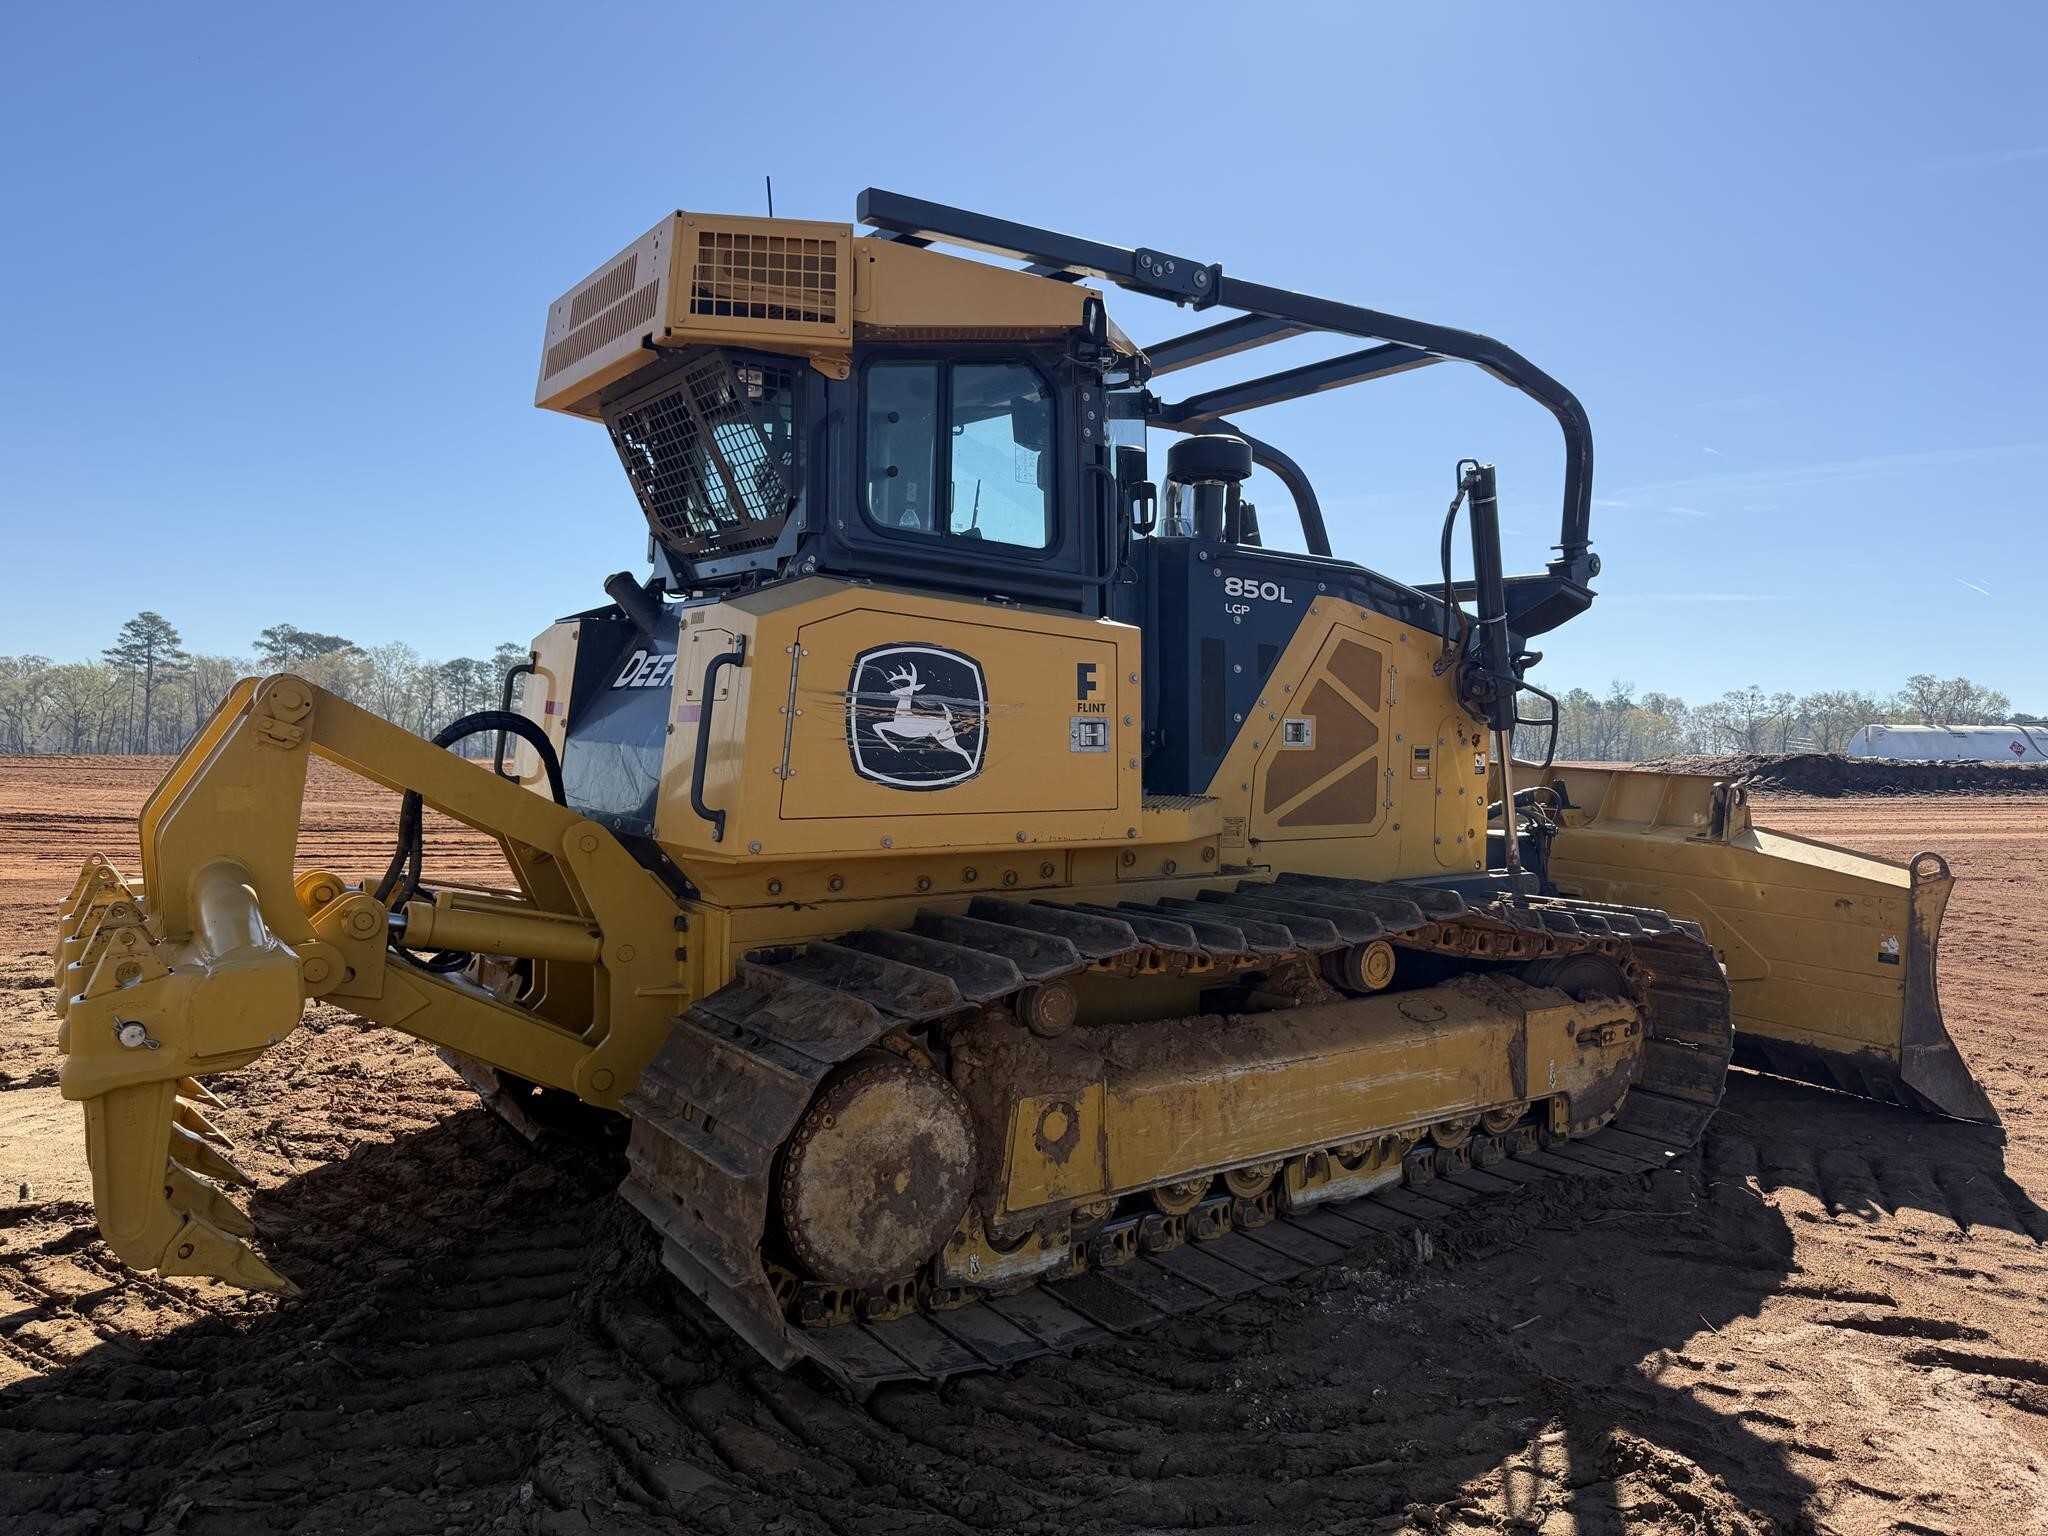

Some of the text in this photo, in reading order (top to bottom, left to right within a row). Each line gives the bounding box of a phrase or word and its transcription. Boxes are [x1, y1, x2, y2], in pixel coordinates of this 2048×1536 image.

[1225, 577, 1293, 603] 850L
[1225, 603, 1250, 615] LGP
[1077, 663, 1096, 700] F
[1077, 703, 1106, 713] FLINT
